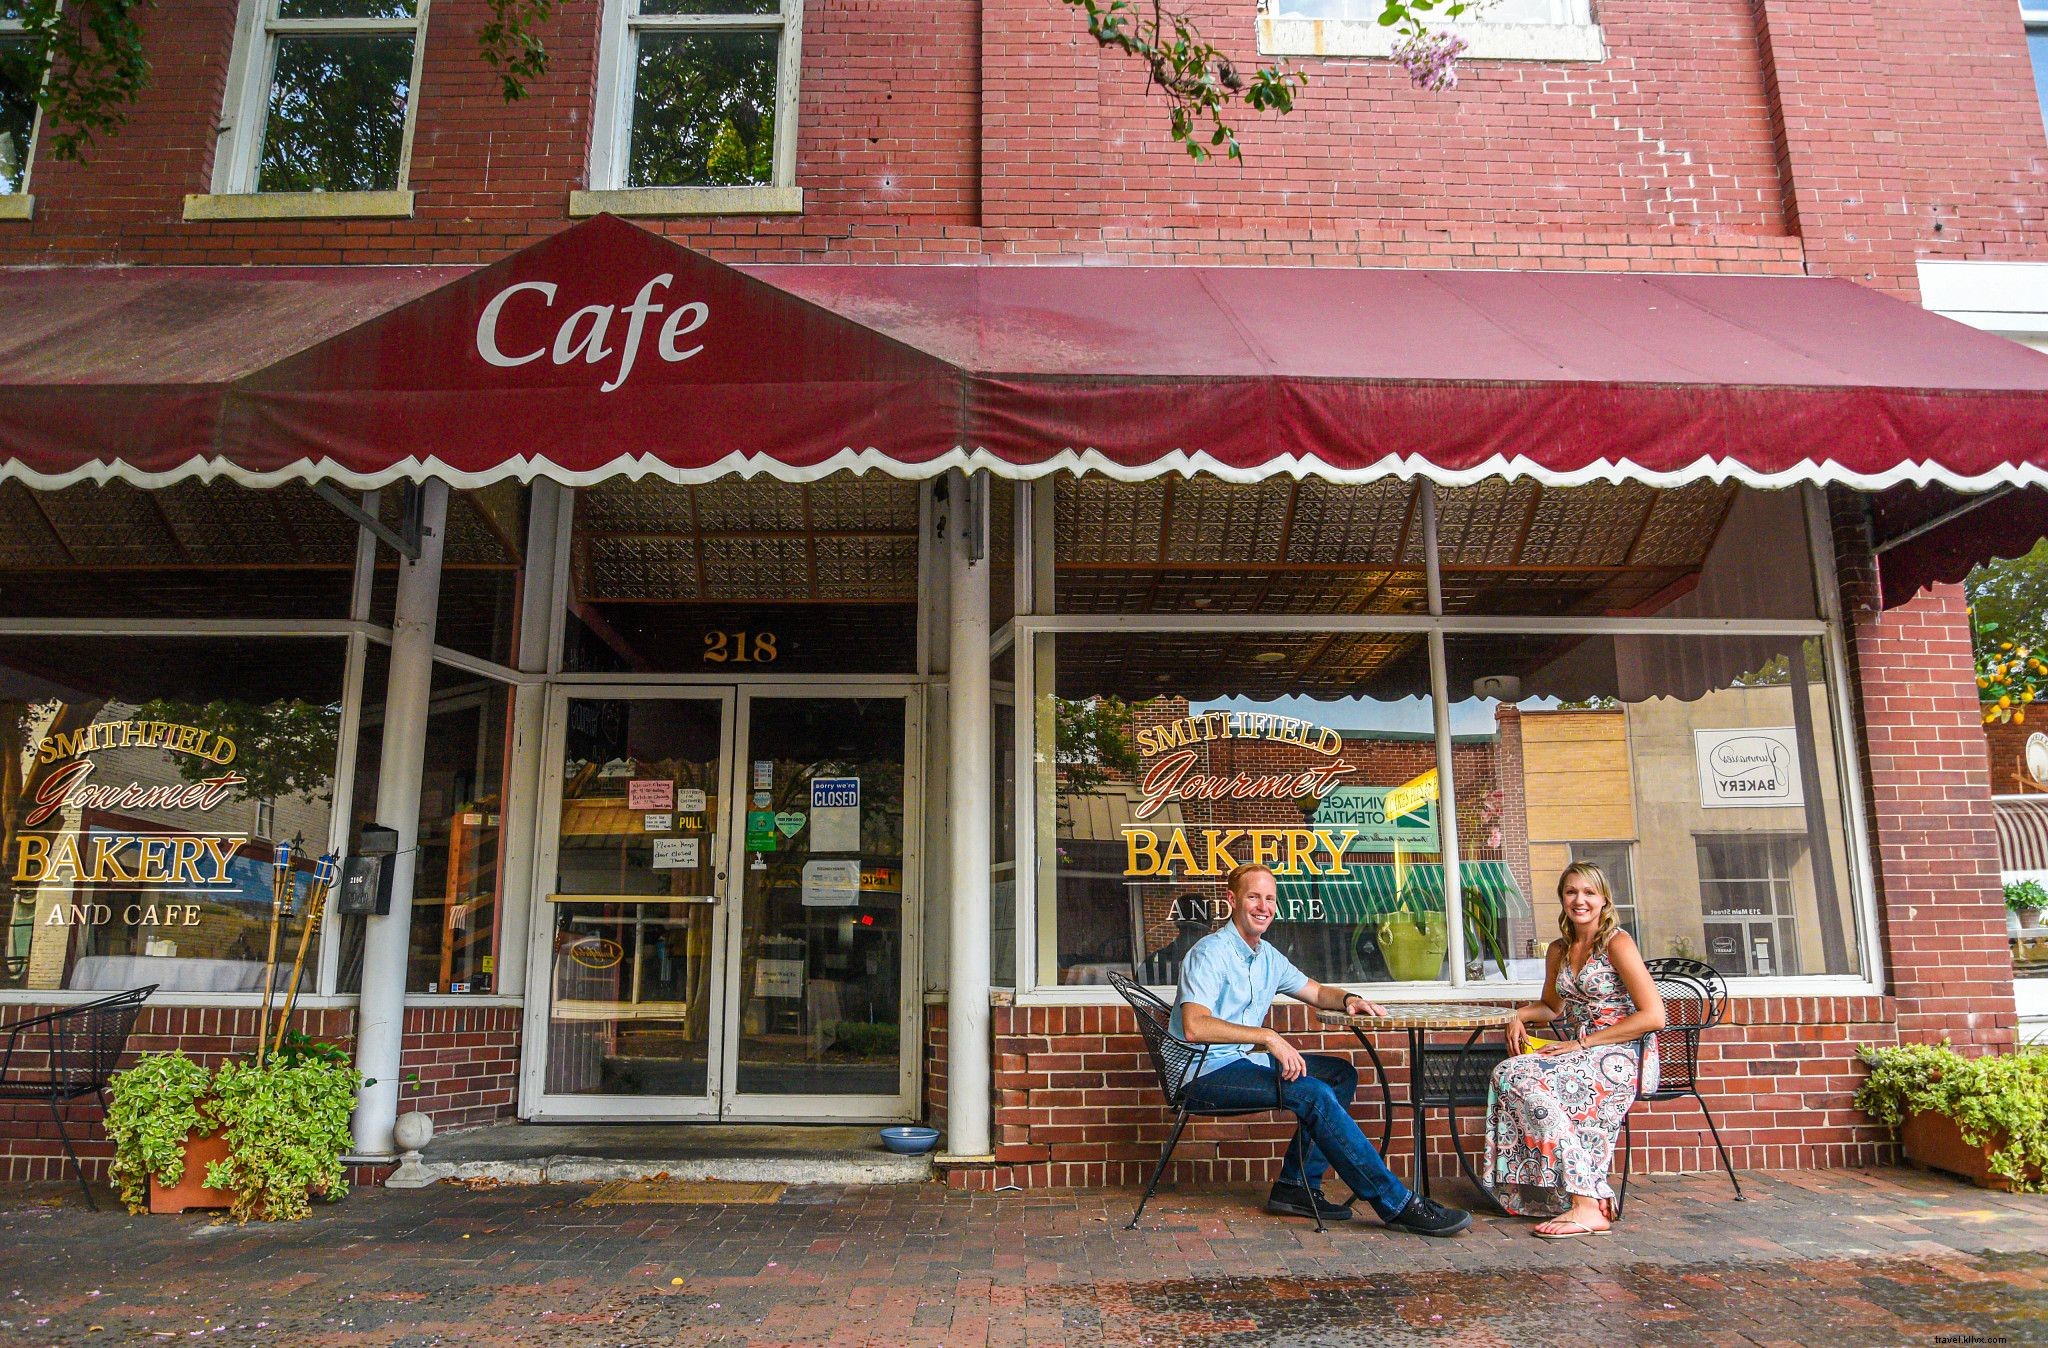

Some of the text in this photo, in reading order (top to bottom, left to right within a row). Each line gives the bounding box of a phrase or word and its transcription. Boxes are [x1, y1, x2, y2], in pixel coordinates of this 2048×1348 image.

[477, 273, 709, 392] Cafe
[703, 631, 778, 663] 218
[38, 720, 237, 765] SMITHFIELD
[1136, 712, 1342, 757] SMITHFIELD
[25, 759, 248, 826] Gourmet
[814, 791, 857, 806] CLOSED
[1135, 750, 1357, 819] Gourmet
[679, 816, 703, 829] PULL
[11, 834, 248, 883] BAKERY
[1121, 827, 1359, 876] BAKERY
[45, 904, 201, 926] AND CAFE
[1166, 899, 1325, 921] AND FE
